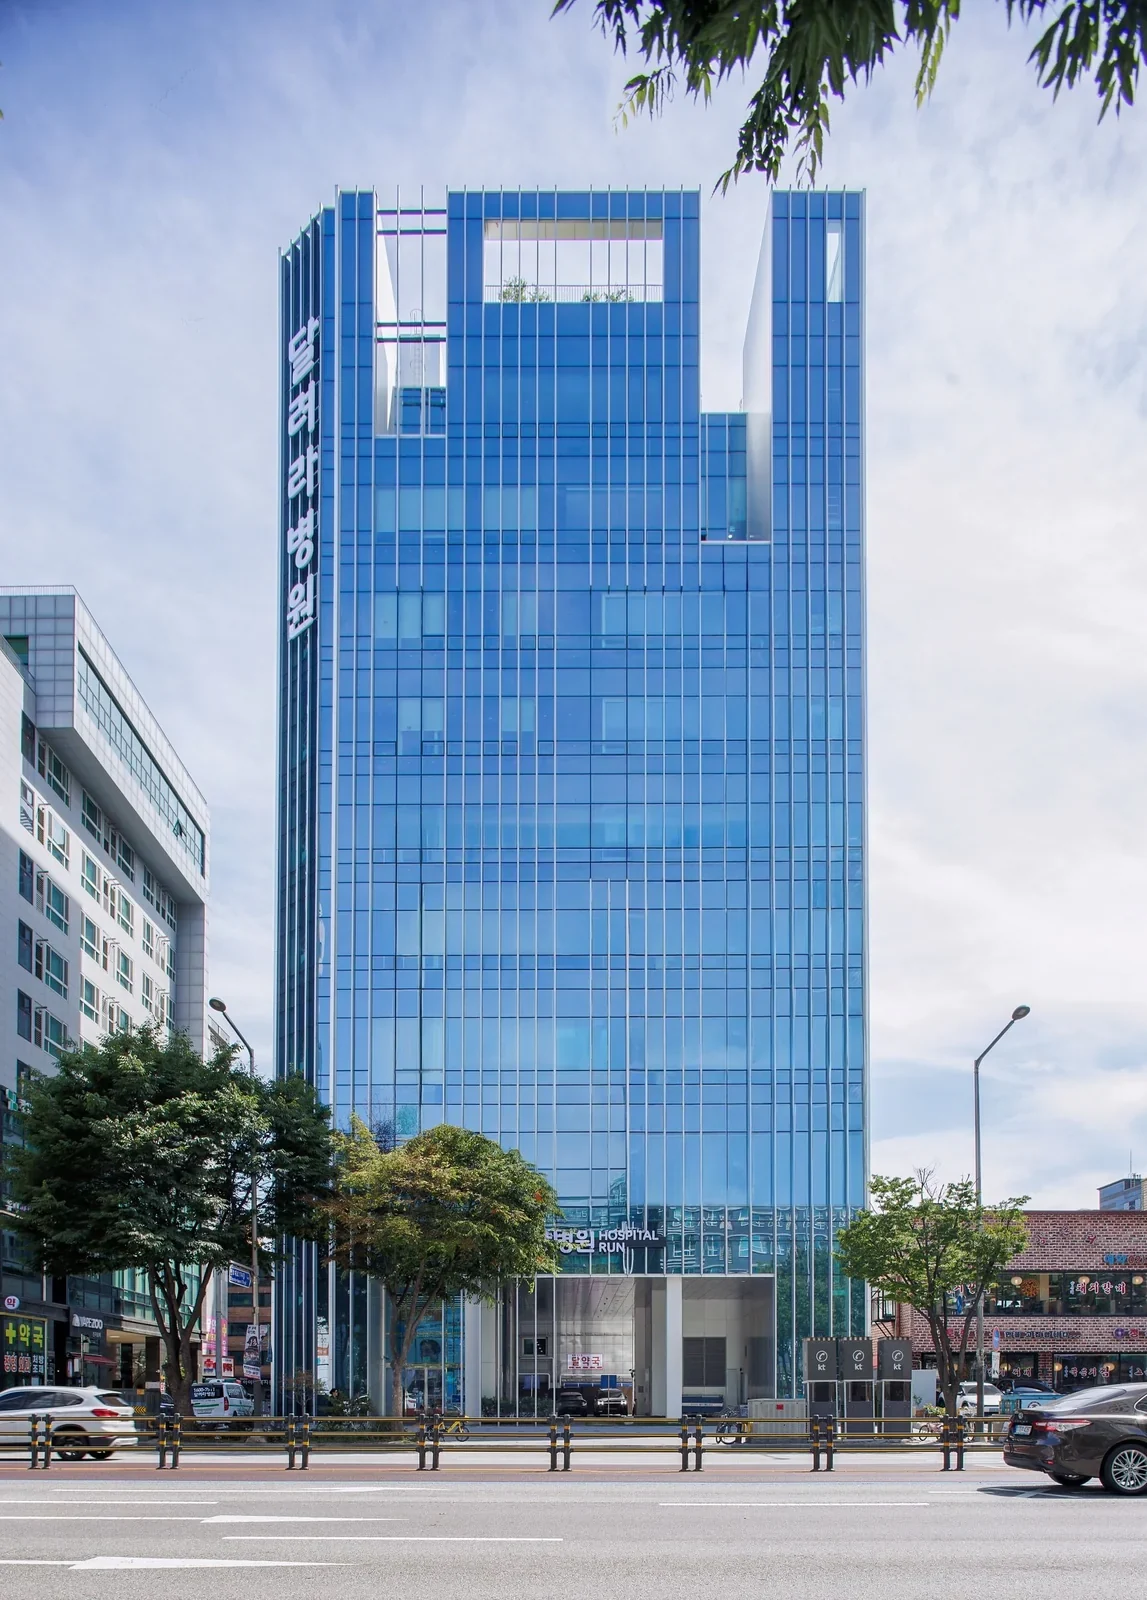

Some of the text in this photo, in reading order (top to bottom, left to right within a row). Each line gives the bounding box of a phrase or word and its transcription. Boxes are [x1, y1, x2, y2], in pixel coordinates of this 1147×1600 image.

[287, 315, 318, 642] 달려라병원
[598, 1229, 659, 1241] HOSPITAL
[598, 1242, 625, 1253] RUN
[6, 1298, 16, 1307] 약
[19, 1324, 44, 1348] 약국
[571, 1356, 600, 1366] 달약국
[817, 1363, 826, 1371] kt
[854, 1363, 863, 1371] kt
[893, 1363, 902, 1371] kt
